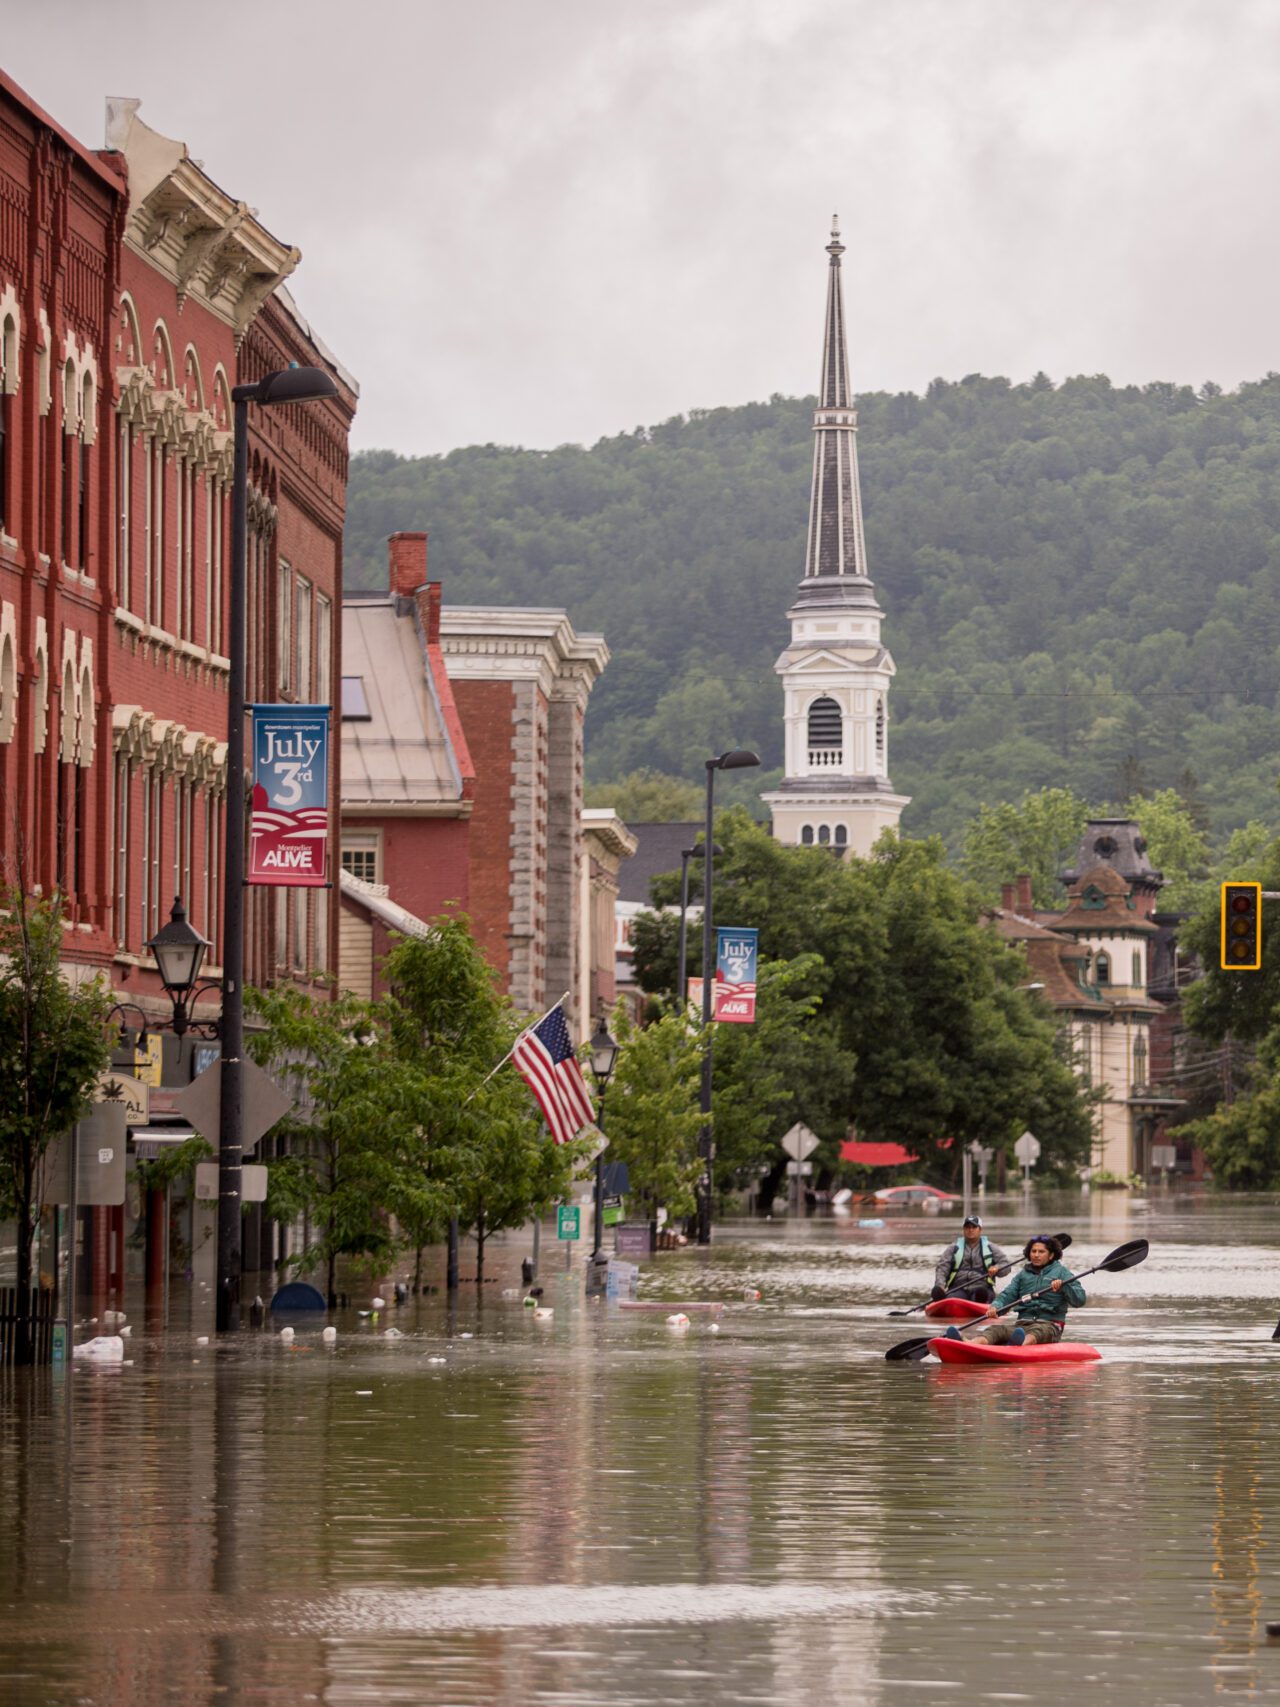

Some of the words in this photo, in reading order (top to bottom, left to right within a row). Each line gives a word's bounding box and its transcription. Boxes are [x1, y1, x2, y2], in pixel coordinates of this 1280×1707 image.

[260, 732, 322, 768] July
[273, 762, 313, 806] 3rd
[277, 844, 313, 852] Montpelier
[262, 851, 313, 868] ALIVE
[720, 942, 754, 962] July
[720, 1003, 748, 1014] ALIVE
